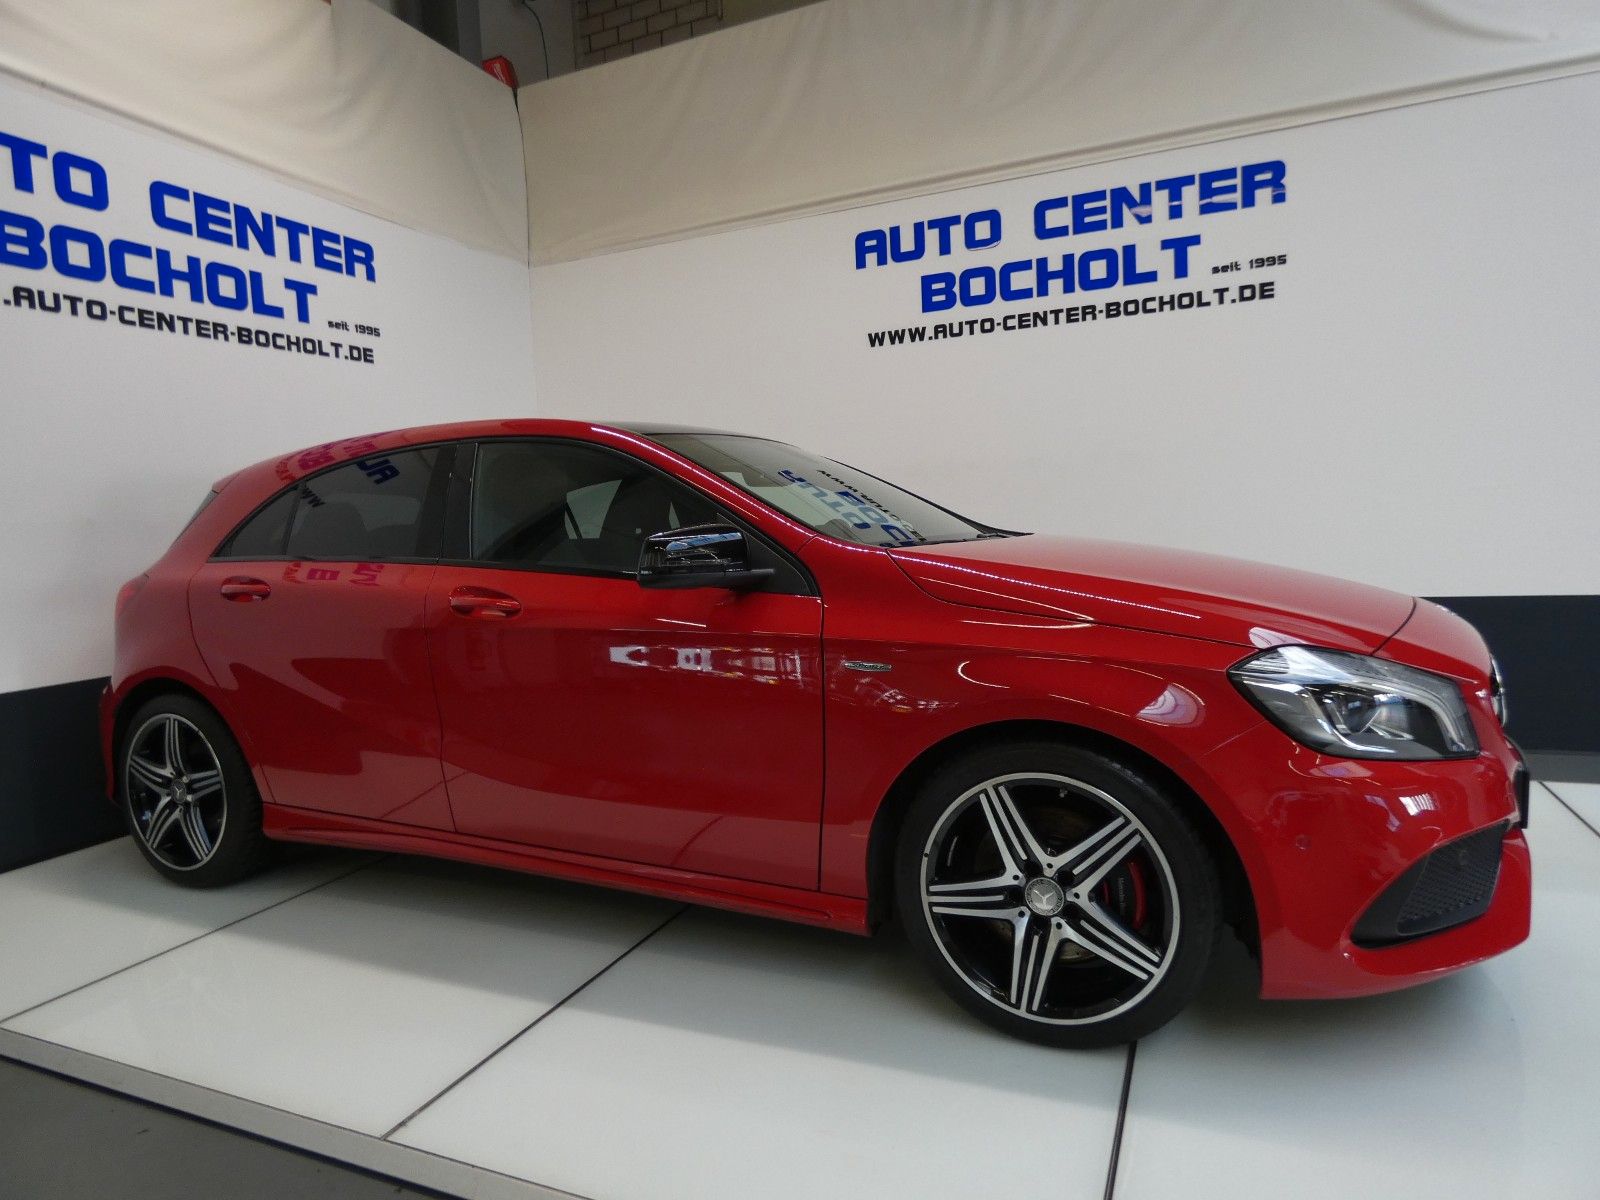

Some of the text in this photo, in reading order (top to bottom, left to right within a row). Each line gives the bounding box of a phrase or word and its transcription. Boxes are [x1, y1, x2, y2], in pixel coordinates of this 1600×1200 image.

[149, 181, 377, 283] CENTER
[854, 159, 1287, 270] AUTO CENTER
[0, 210, 318, 324] BOCHOLT
[921, 234, 1202, 314] BOCHOLT
[1211, 254, 1287, 275] seit 1995
[327, 320, 381, 338] seit 1995
[867, 281, 1276, 348] WWW.AUTO-CENTER-BOCHOLT.DE
